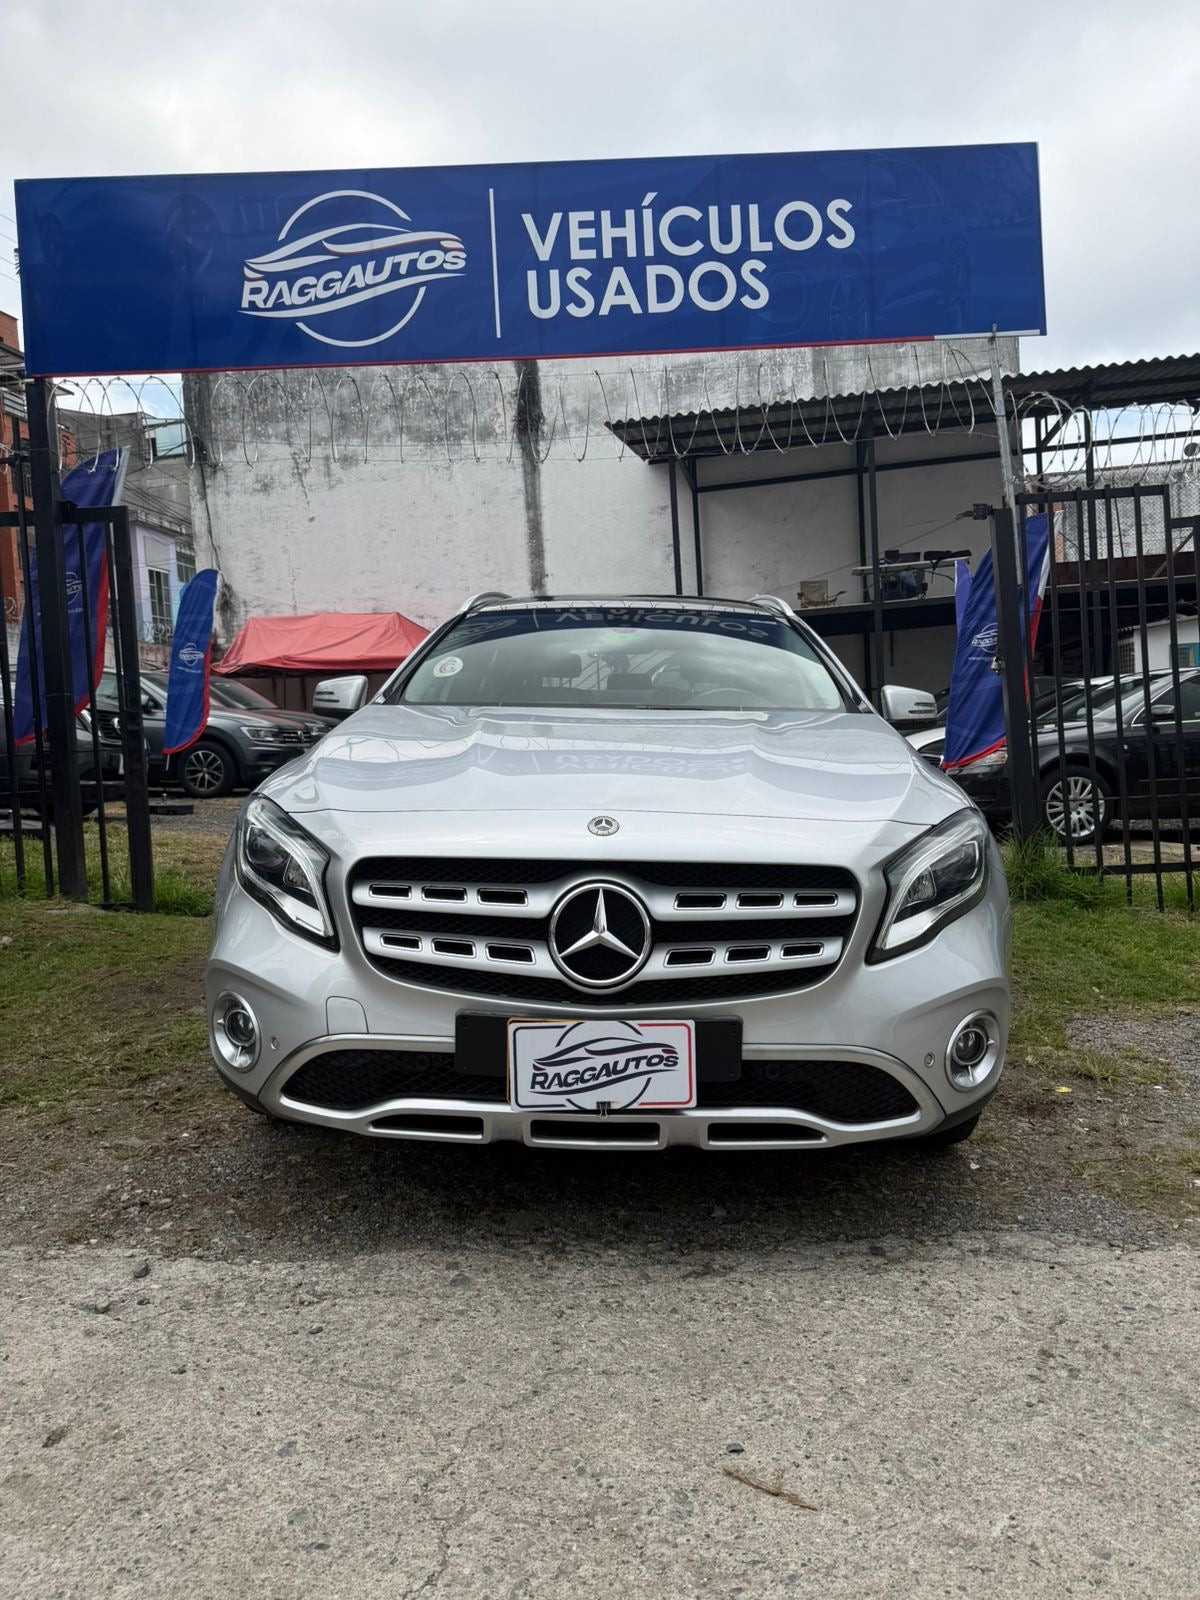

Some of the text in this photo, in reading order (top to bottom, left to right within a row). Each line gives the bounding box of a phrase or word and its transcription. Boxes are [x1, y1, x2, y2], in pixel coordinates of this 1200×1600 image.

[521, 191, 856, 262] VEHÍCULOS
[240, 249, 468, 309] RAGGAUTOS
[526, 259, 770, 319] USADOS
[530, 1053, 680, 1090] RAGGAUTOS
